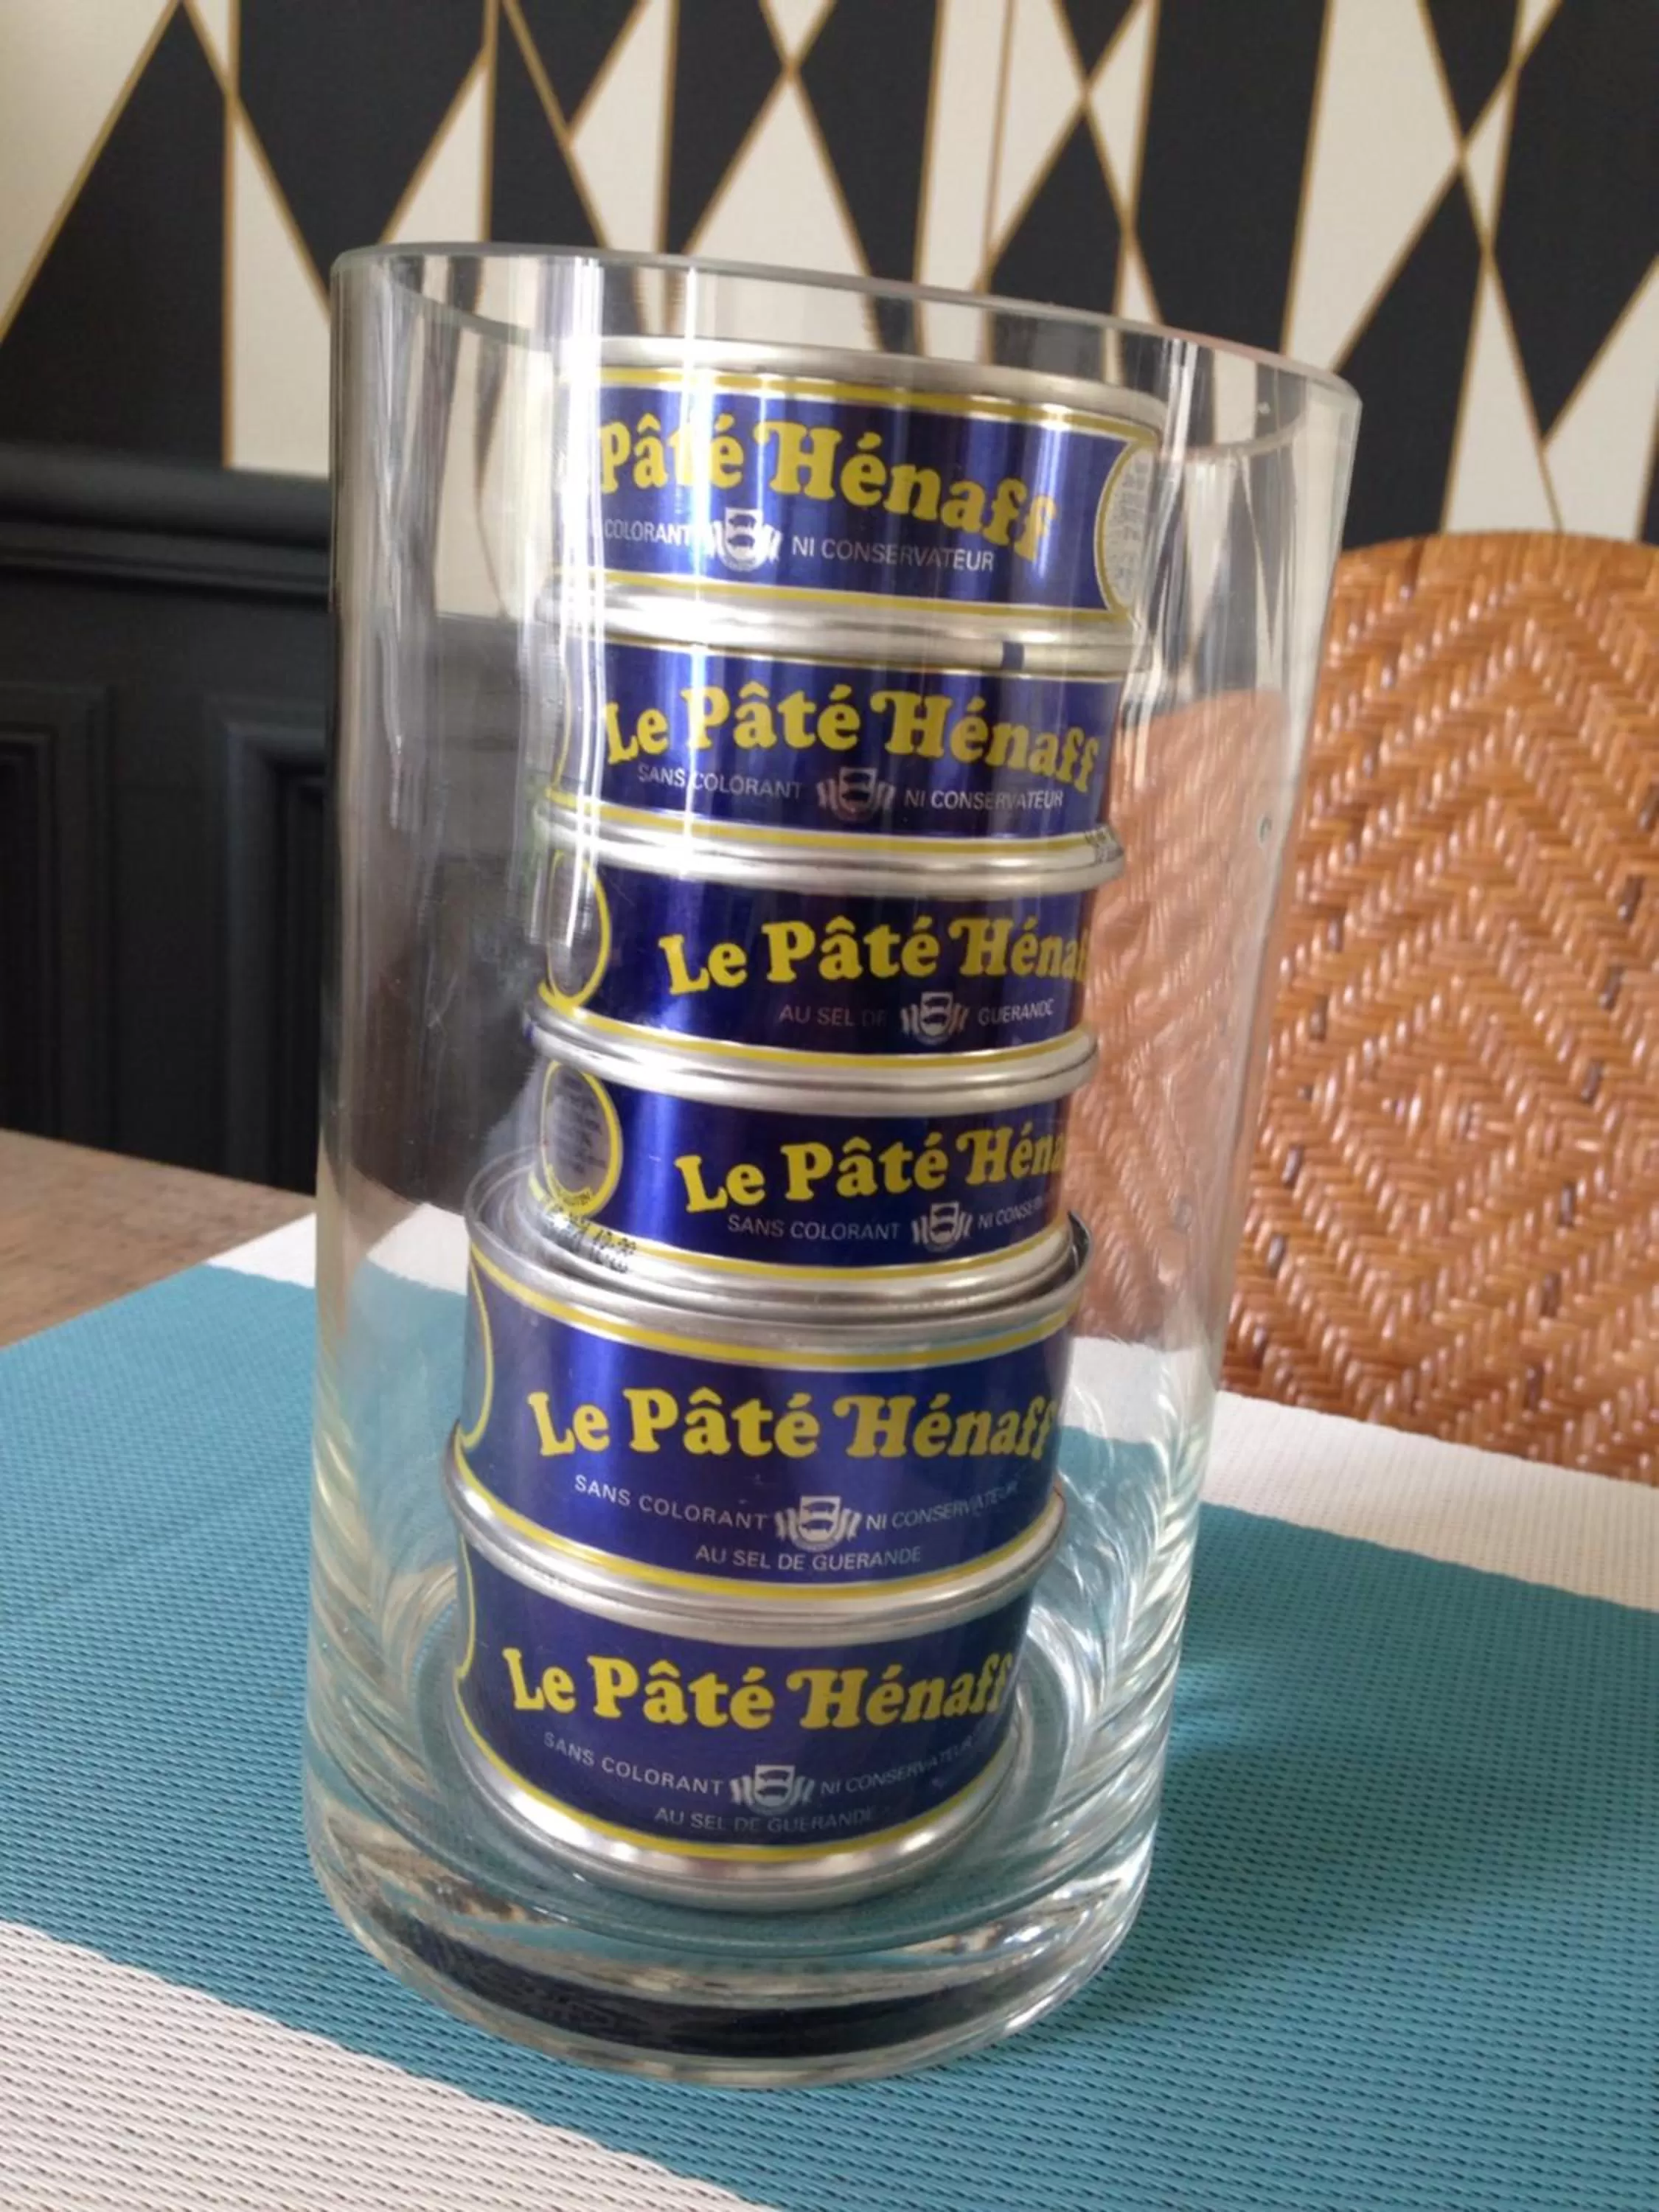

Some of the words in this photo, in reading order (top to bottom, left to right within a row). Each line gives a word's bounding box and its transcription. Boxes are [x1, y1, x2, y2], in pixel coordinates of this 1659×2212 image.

[753, 420, 1056, 563] Hénaff
[605, 518, 693, 547] COLORANT
[793, 538, 815, 557] NI
[822, 538, 994, 572] CONSERVATEUR
[603, 701, 669, 765] Le
[680, 681, 860, 751] Pâté
[870, 689, 1099, 793] Hénaff
[638, 762, 686, 790] SANS
[692, 772, 803, 799] COLORANT
[904, 790, 925, 808] NI
[931, 789, 1064, 812] CONSERVATEUR
[658, 933, 748, 995] Le
[762, 915, 940, 982] Pâté
[779, 1004, 811, 1025] AU
[817, 1006, 855, 1027] SEL
[674, 1154, 765, 1214] Le
[780, 1132, 948, 1201] Pâté
[728, 1214, 784, 1239] SANS
[790, 1219, 900, 1242] COLORANT
[978, 1211, 994, 1230] NI
[526, 1391, 611, 1457] Le
[622, 1386, 821, 1458] Pâté
[832, 1391, 1058, 1461] Hénaff
[574, 1474, 630, 1507] SANS
[639, 1494, 768, 1531] COLORANT
[866, 1512, 888, 1531] NI
[695, 1544, 727, 1564] AU
[732, 1549, 771, 1570] SEL
[778, 1553, 806, 1571] DE
[812, 1545, 921, 1572] GUERANDE
[502, 1647, 576, 1714] Le
[587, 1659, 775, 1731] Pâté
[786, 1652, 1013, 1730] Hénaff
[543, 1732, 595, 1767] SANS
[601, 1757, 725, 1797] COLORANT
[821, 1780, 841, 1795] NI
[655, 1807, 685, 1826] AU
[690, 1812, 723, 1830] SEL
